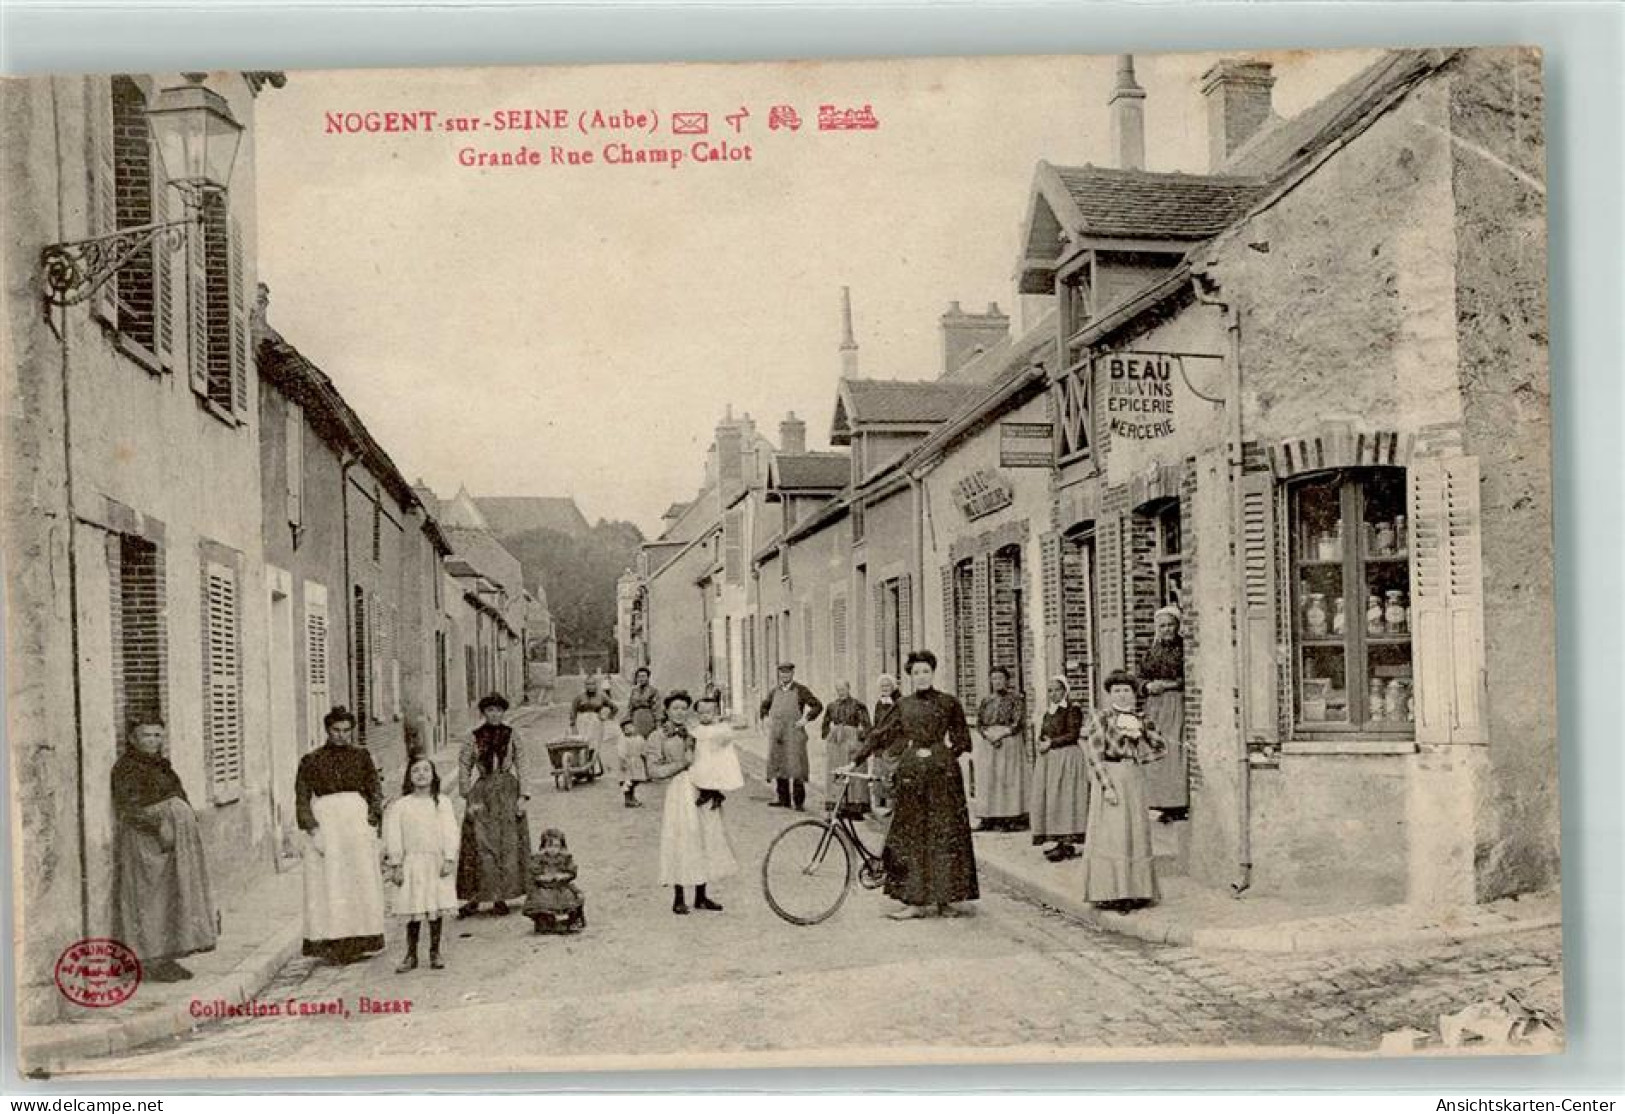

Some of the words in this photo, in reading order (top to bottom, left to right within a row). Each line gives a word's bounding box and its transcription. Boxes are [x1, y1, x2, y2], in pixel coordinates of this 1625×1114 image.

[1110, 359, 1170, 381] BEAU
[1136, 382, 1174, 398] VINS
[1108, 397, 1174, 414] EPICERIE
[1109, 417, 1176, 440] MERCERIE
